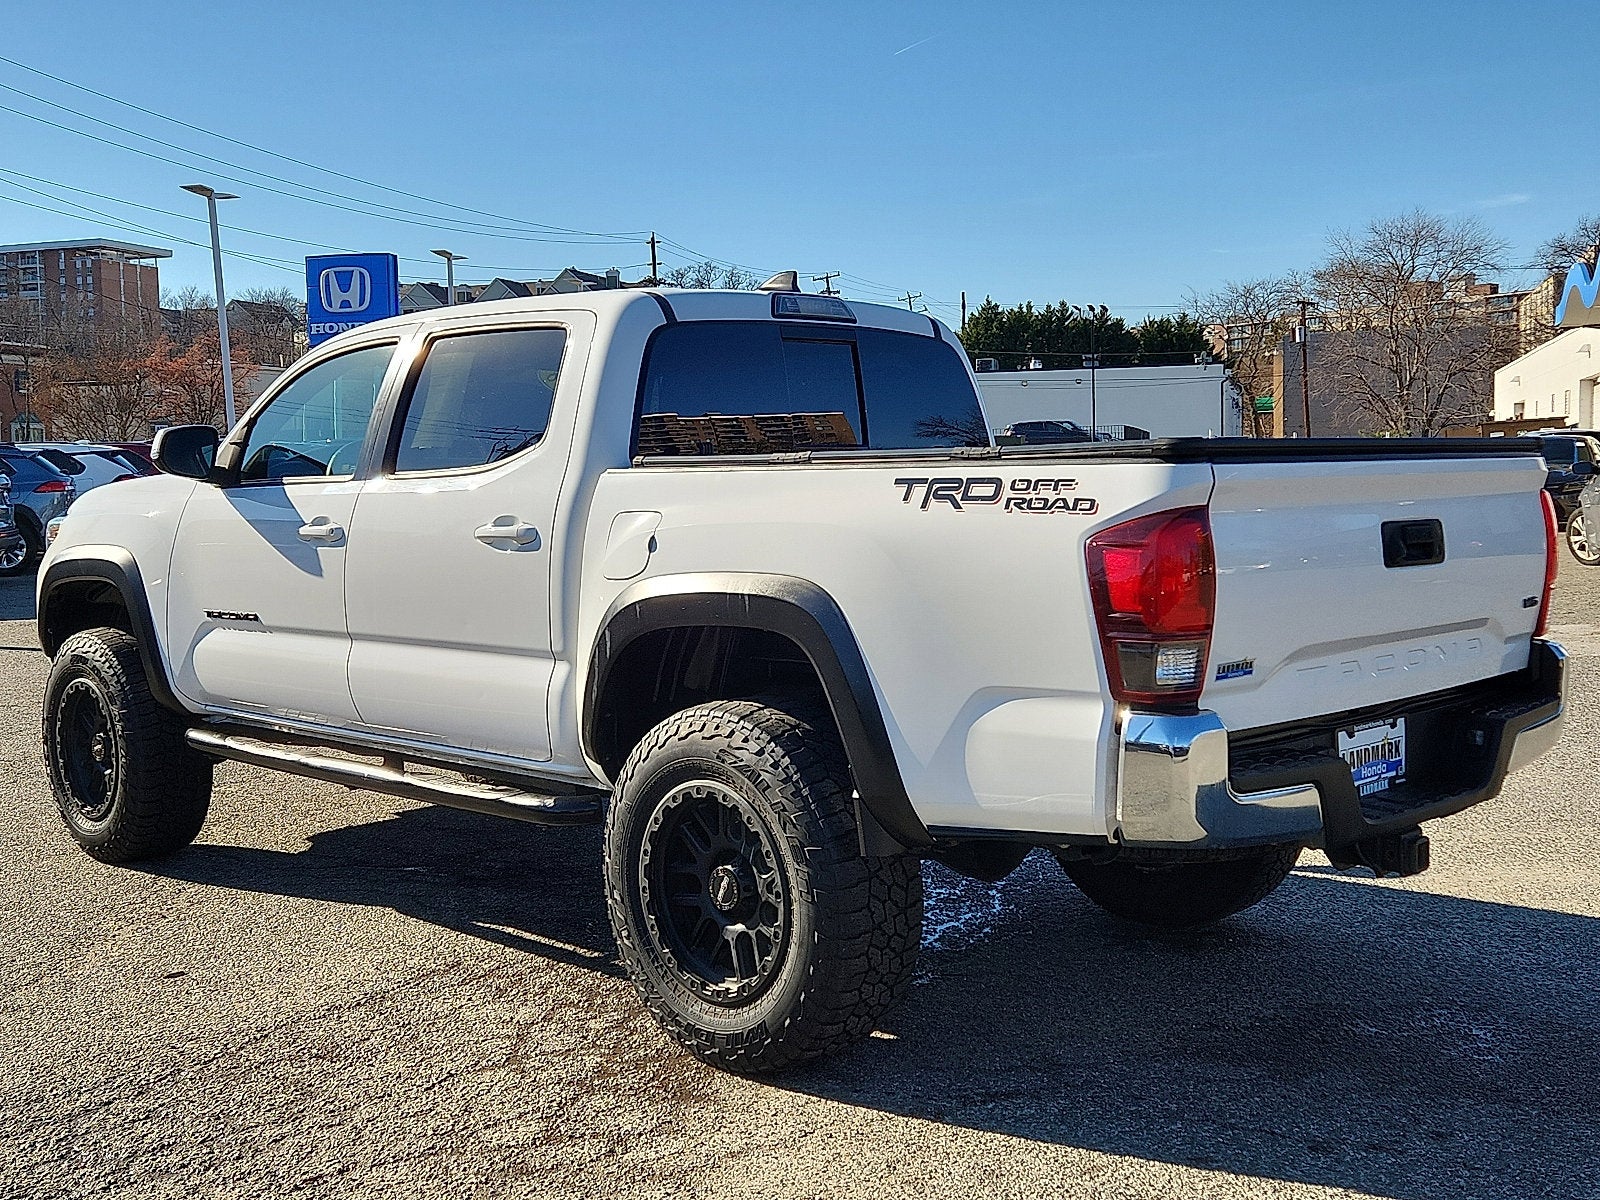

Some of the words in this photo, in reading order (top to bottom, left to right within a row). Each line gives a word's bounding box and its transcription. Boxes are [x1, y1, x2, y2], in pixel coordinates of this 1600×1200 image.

[310, 322, 365, 334] HON
[893, 477, 1005, 512] TRD
[1010, 478, 1079, 495] OFF
[1004, 497, 1099, 515] ROAD
[1361, 762, 1387, 779] Honda
